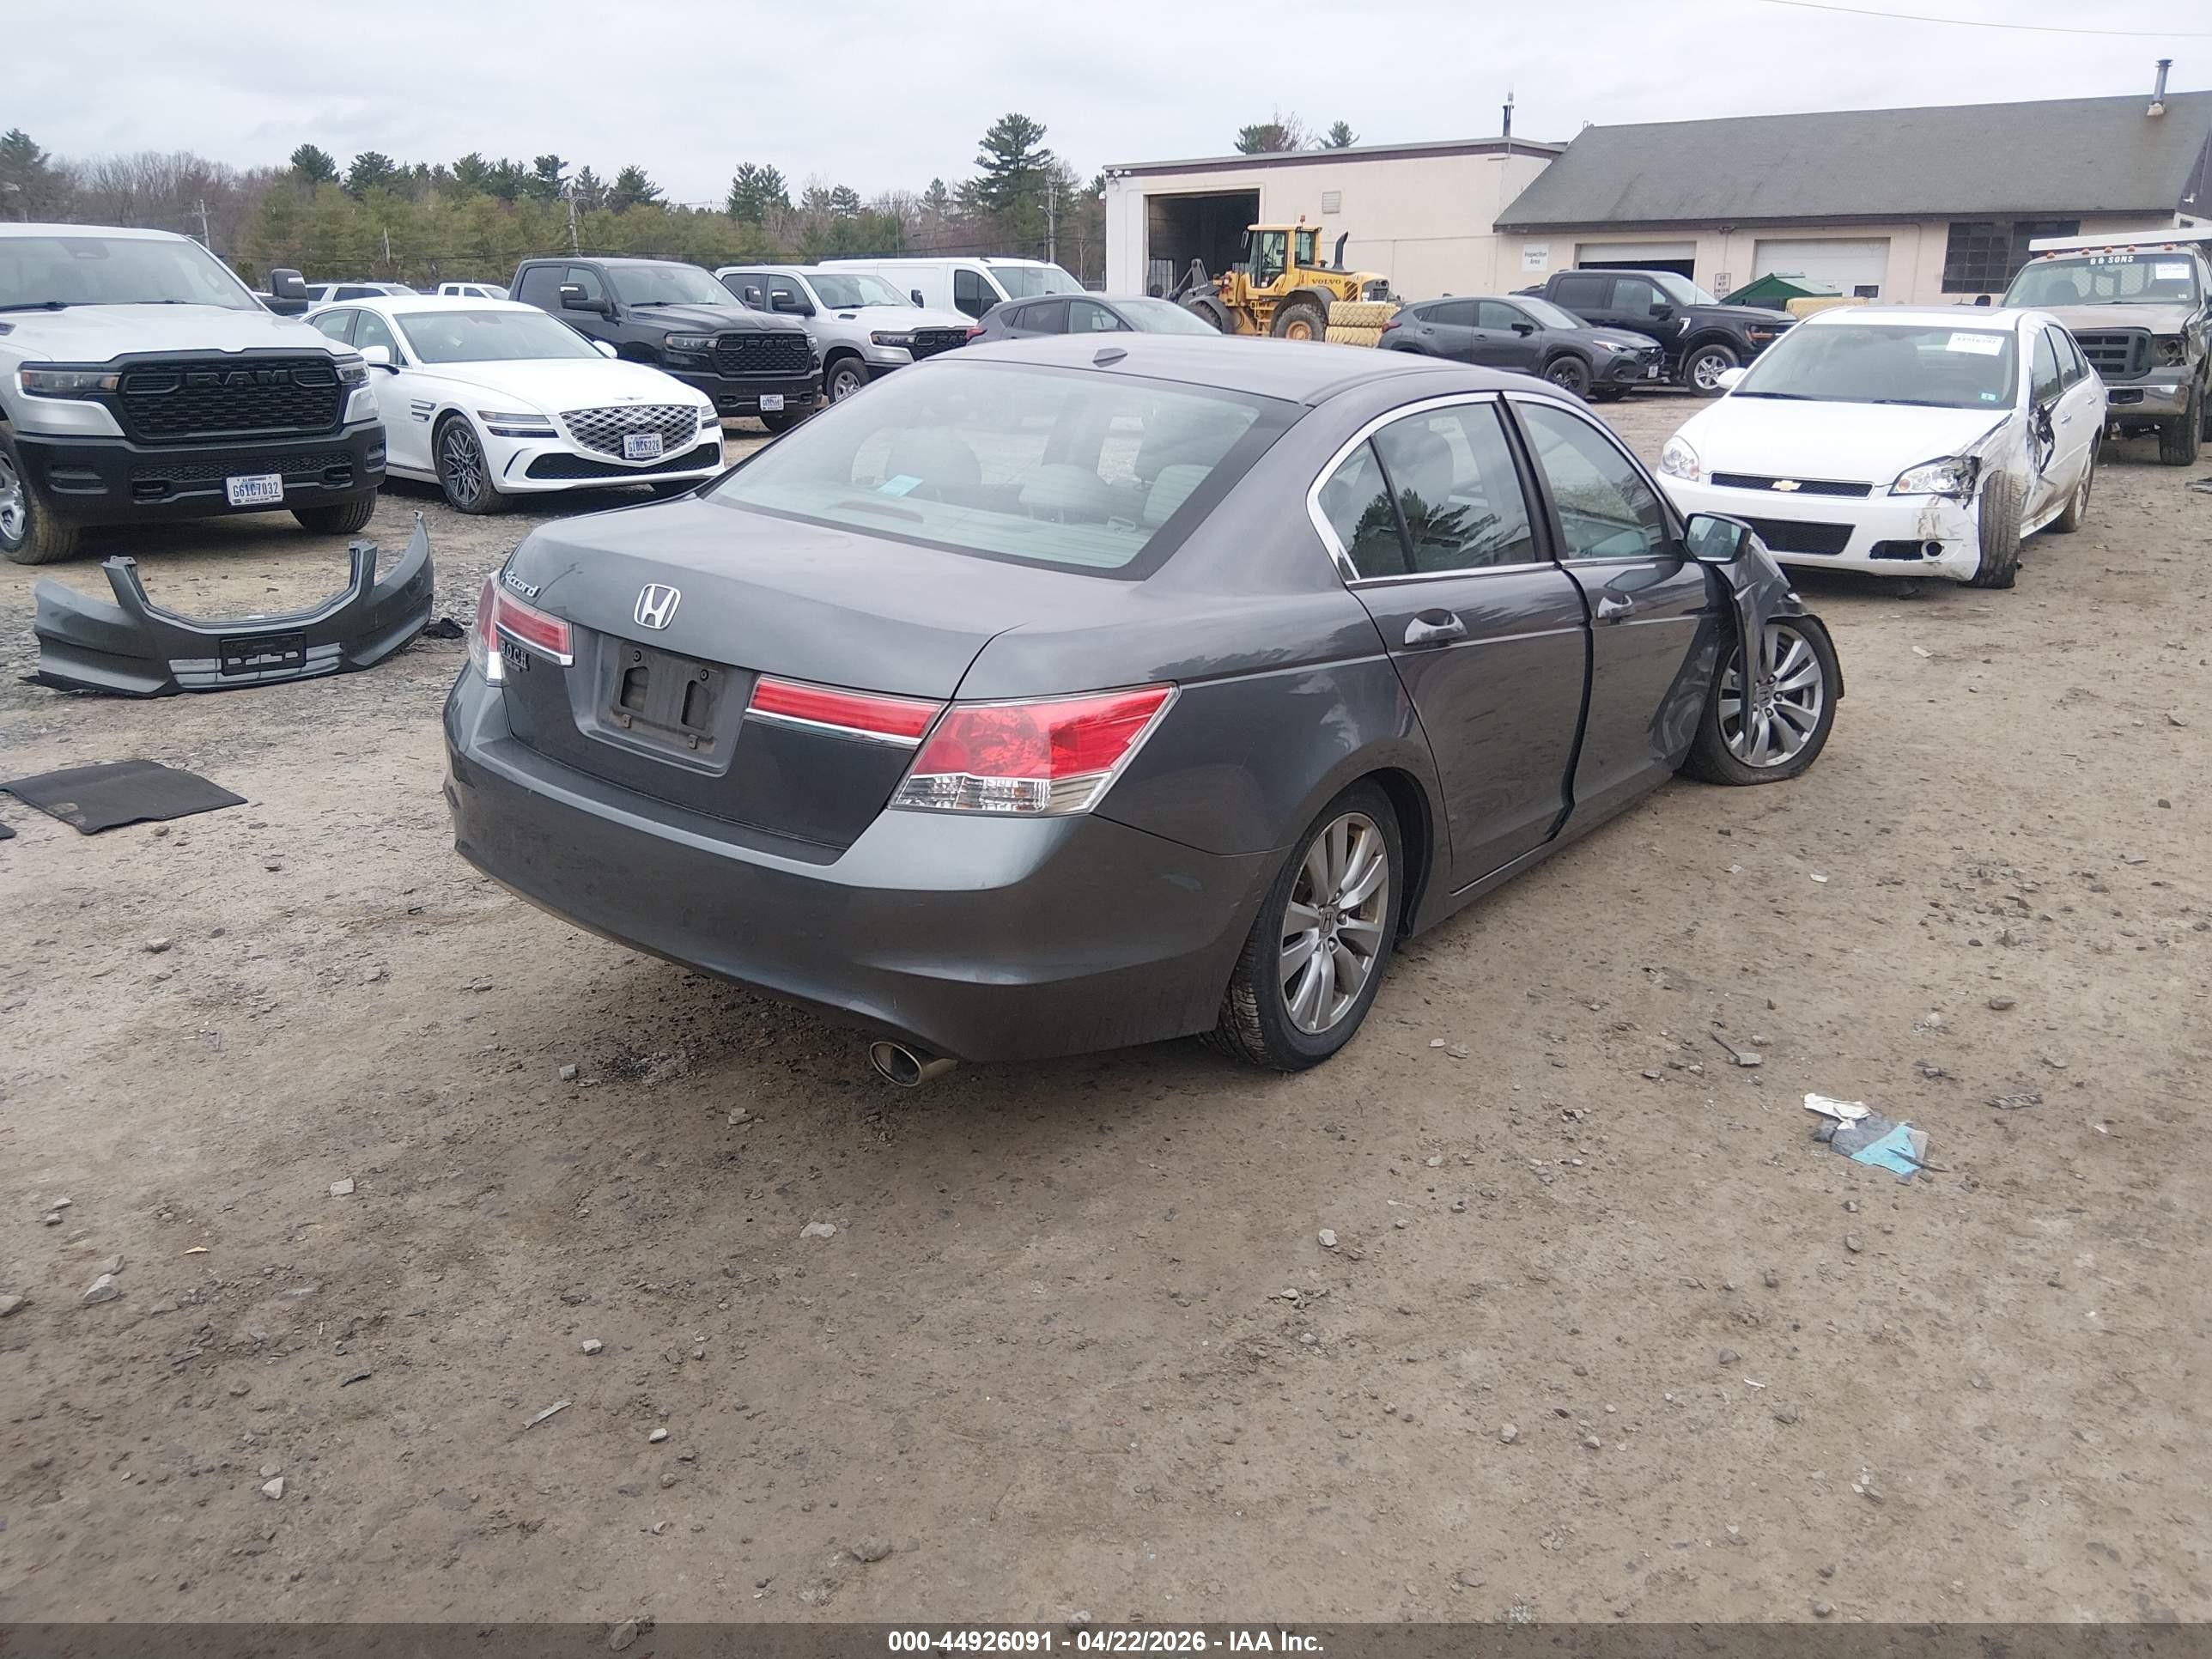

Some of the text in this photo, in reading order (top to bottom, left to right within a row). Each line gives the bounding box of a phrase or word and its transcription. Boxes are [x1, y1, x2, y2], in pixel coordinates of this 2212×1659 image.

[2107, 255, 2135, 264] SONS
[185, 368, 289, 386] RAM
[233, 481, 279, 497] G61C7032
[501, 570, 539, 598] Accord
[501, 640, 526, 668] BOCH
